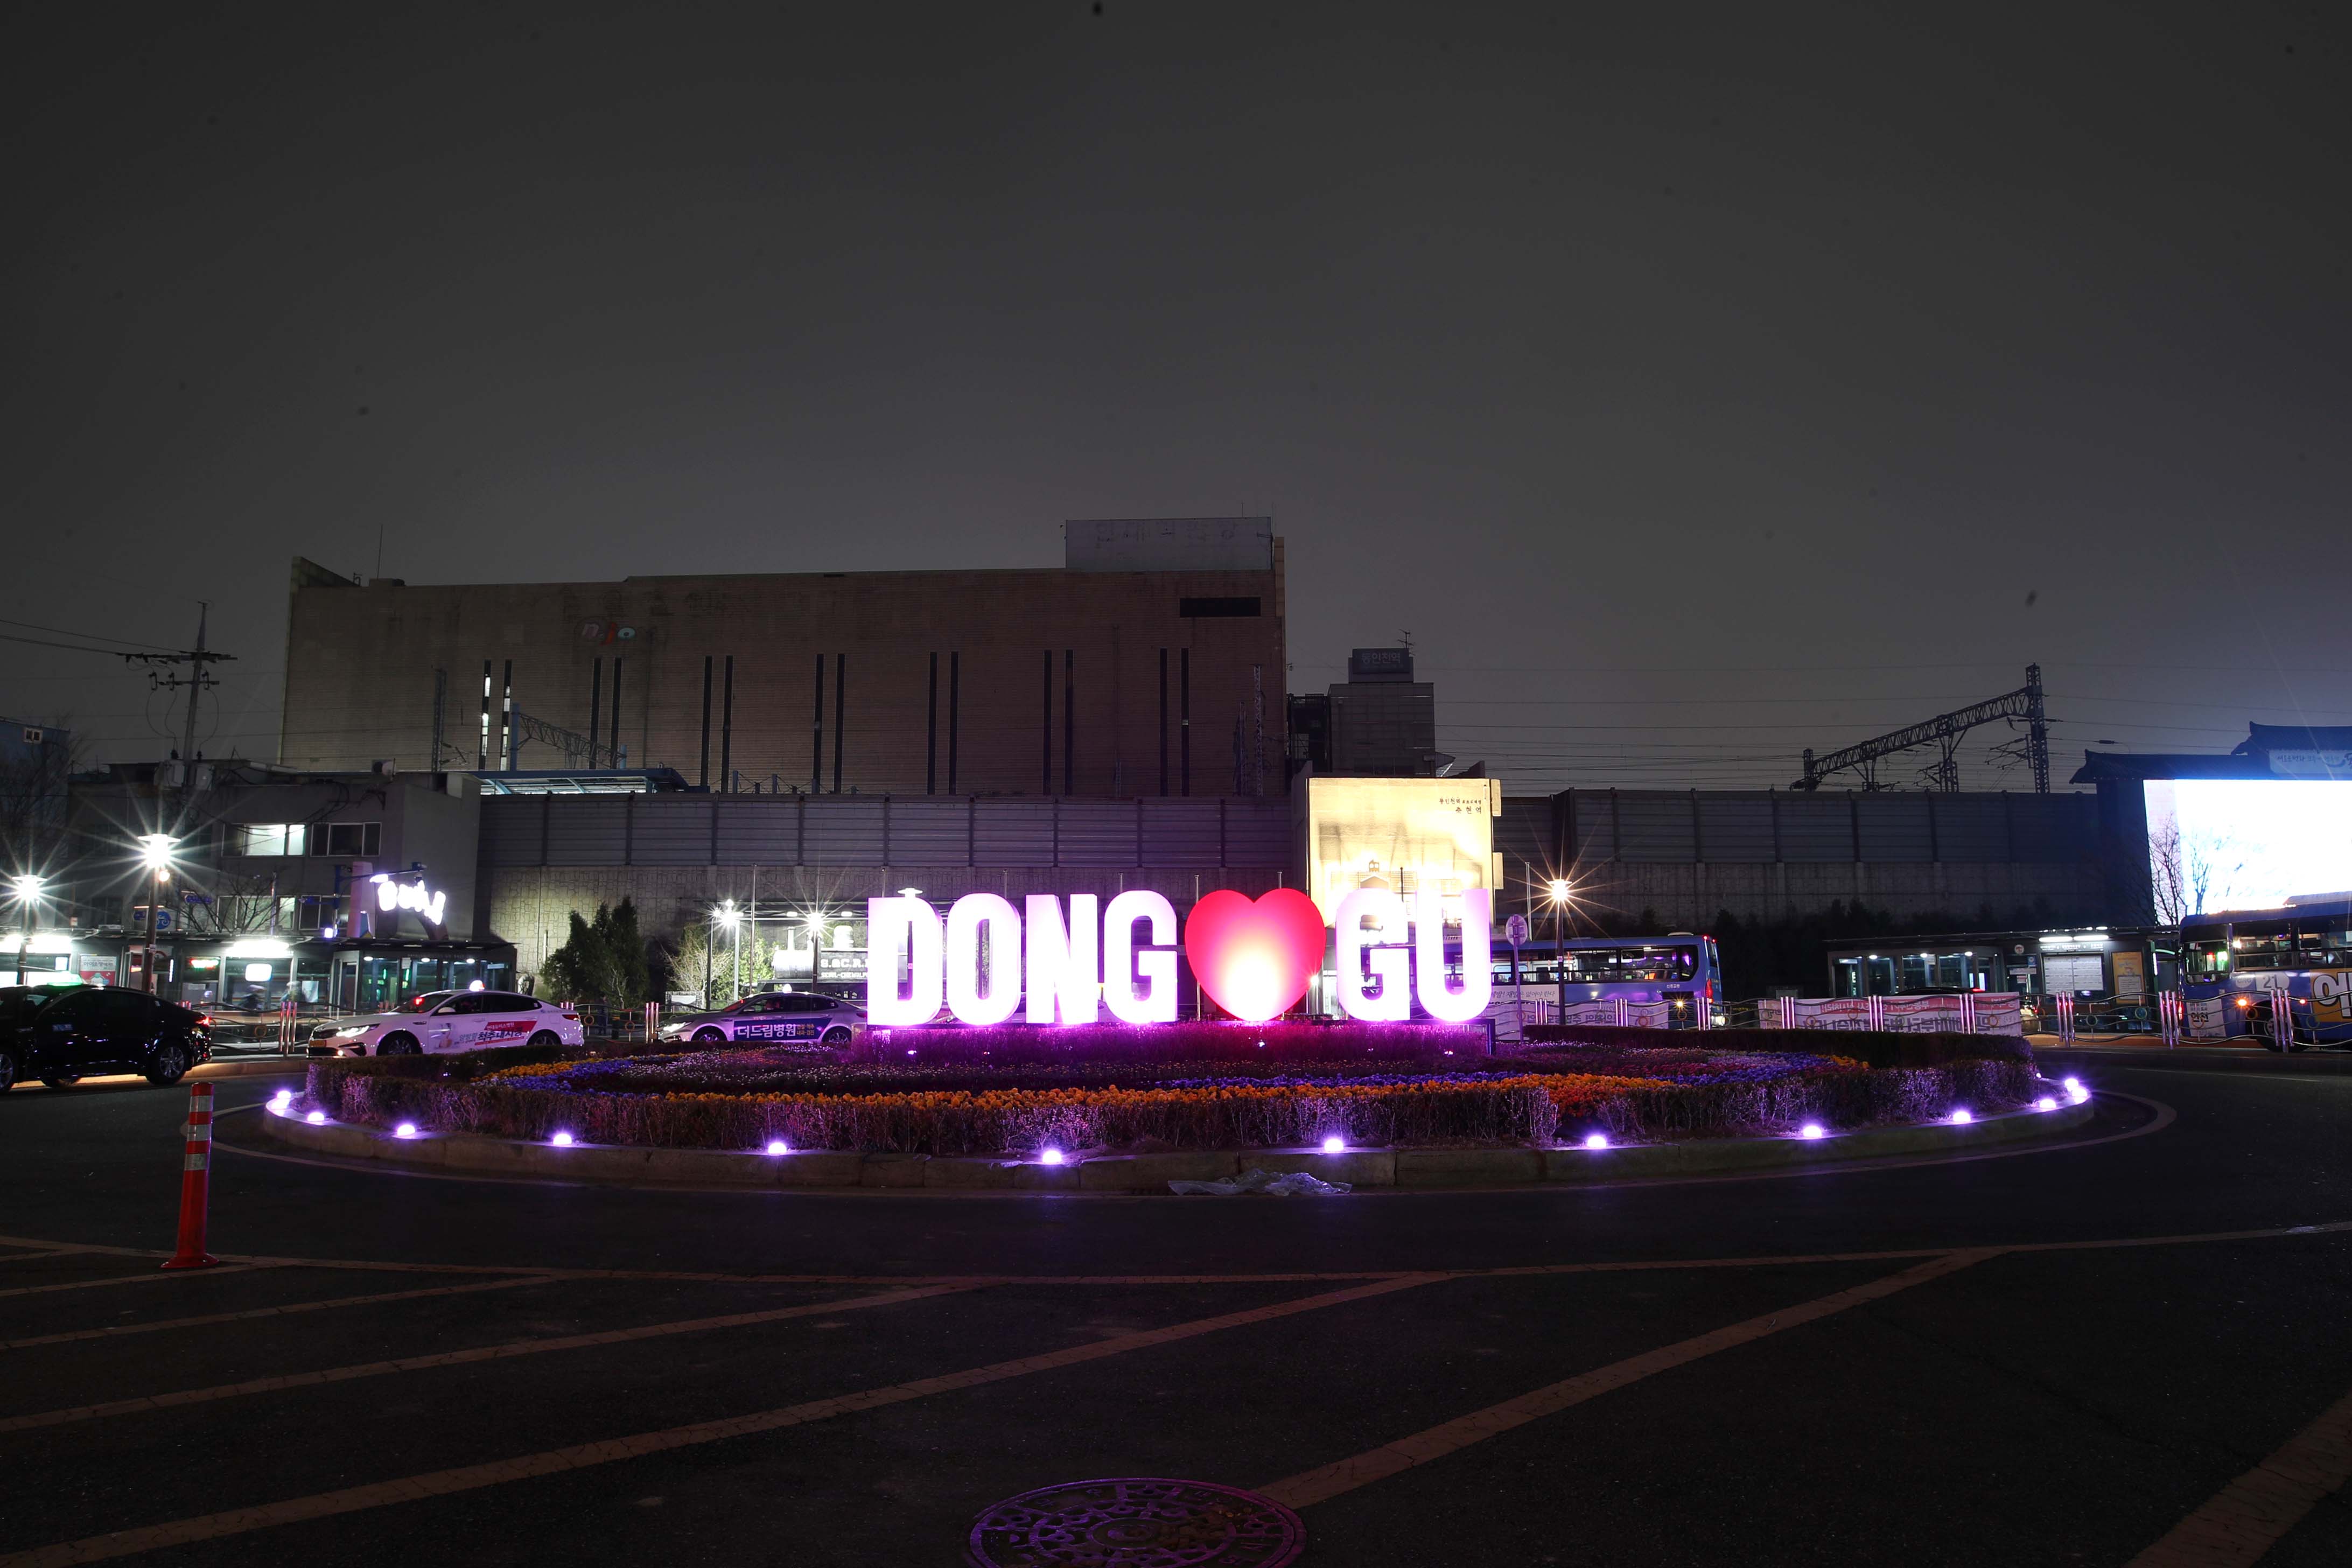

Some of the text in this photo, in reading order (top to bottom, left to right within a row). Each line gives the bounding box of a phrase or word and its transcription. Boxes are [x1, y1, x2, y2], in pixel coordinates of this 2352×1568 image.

[867, 888, 1493, 1025] DONG GU
[737, 1023, 796, 1039] 더드림병원
